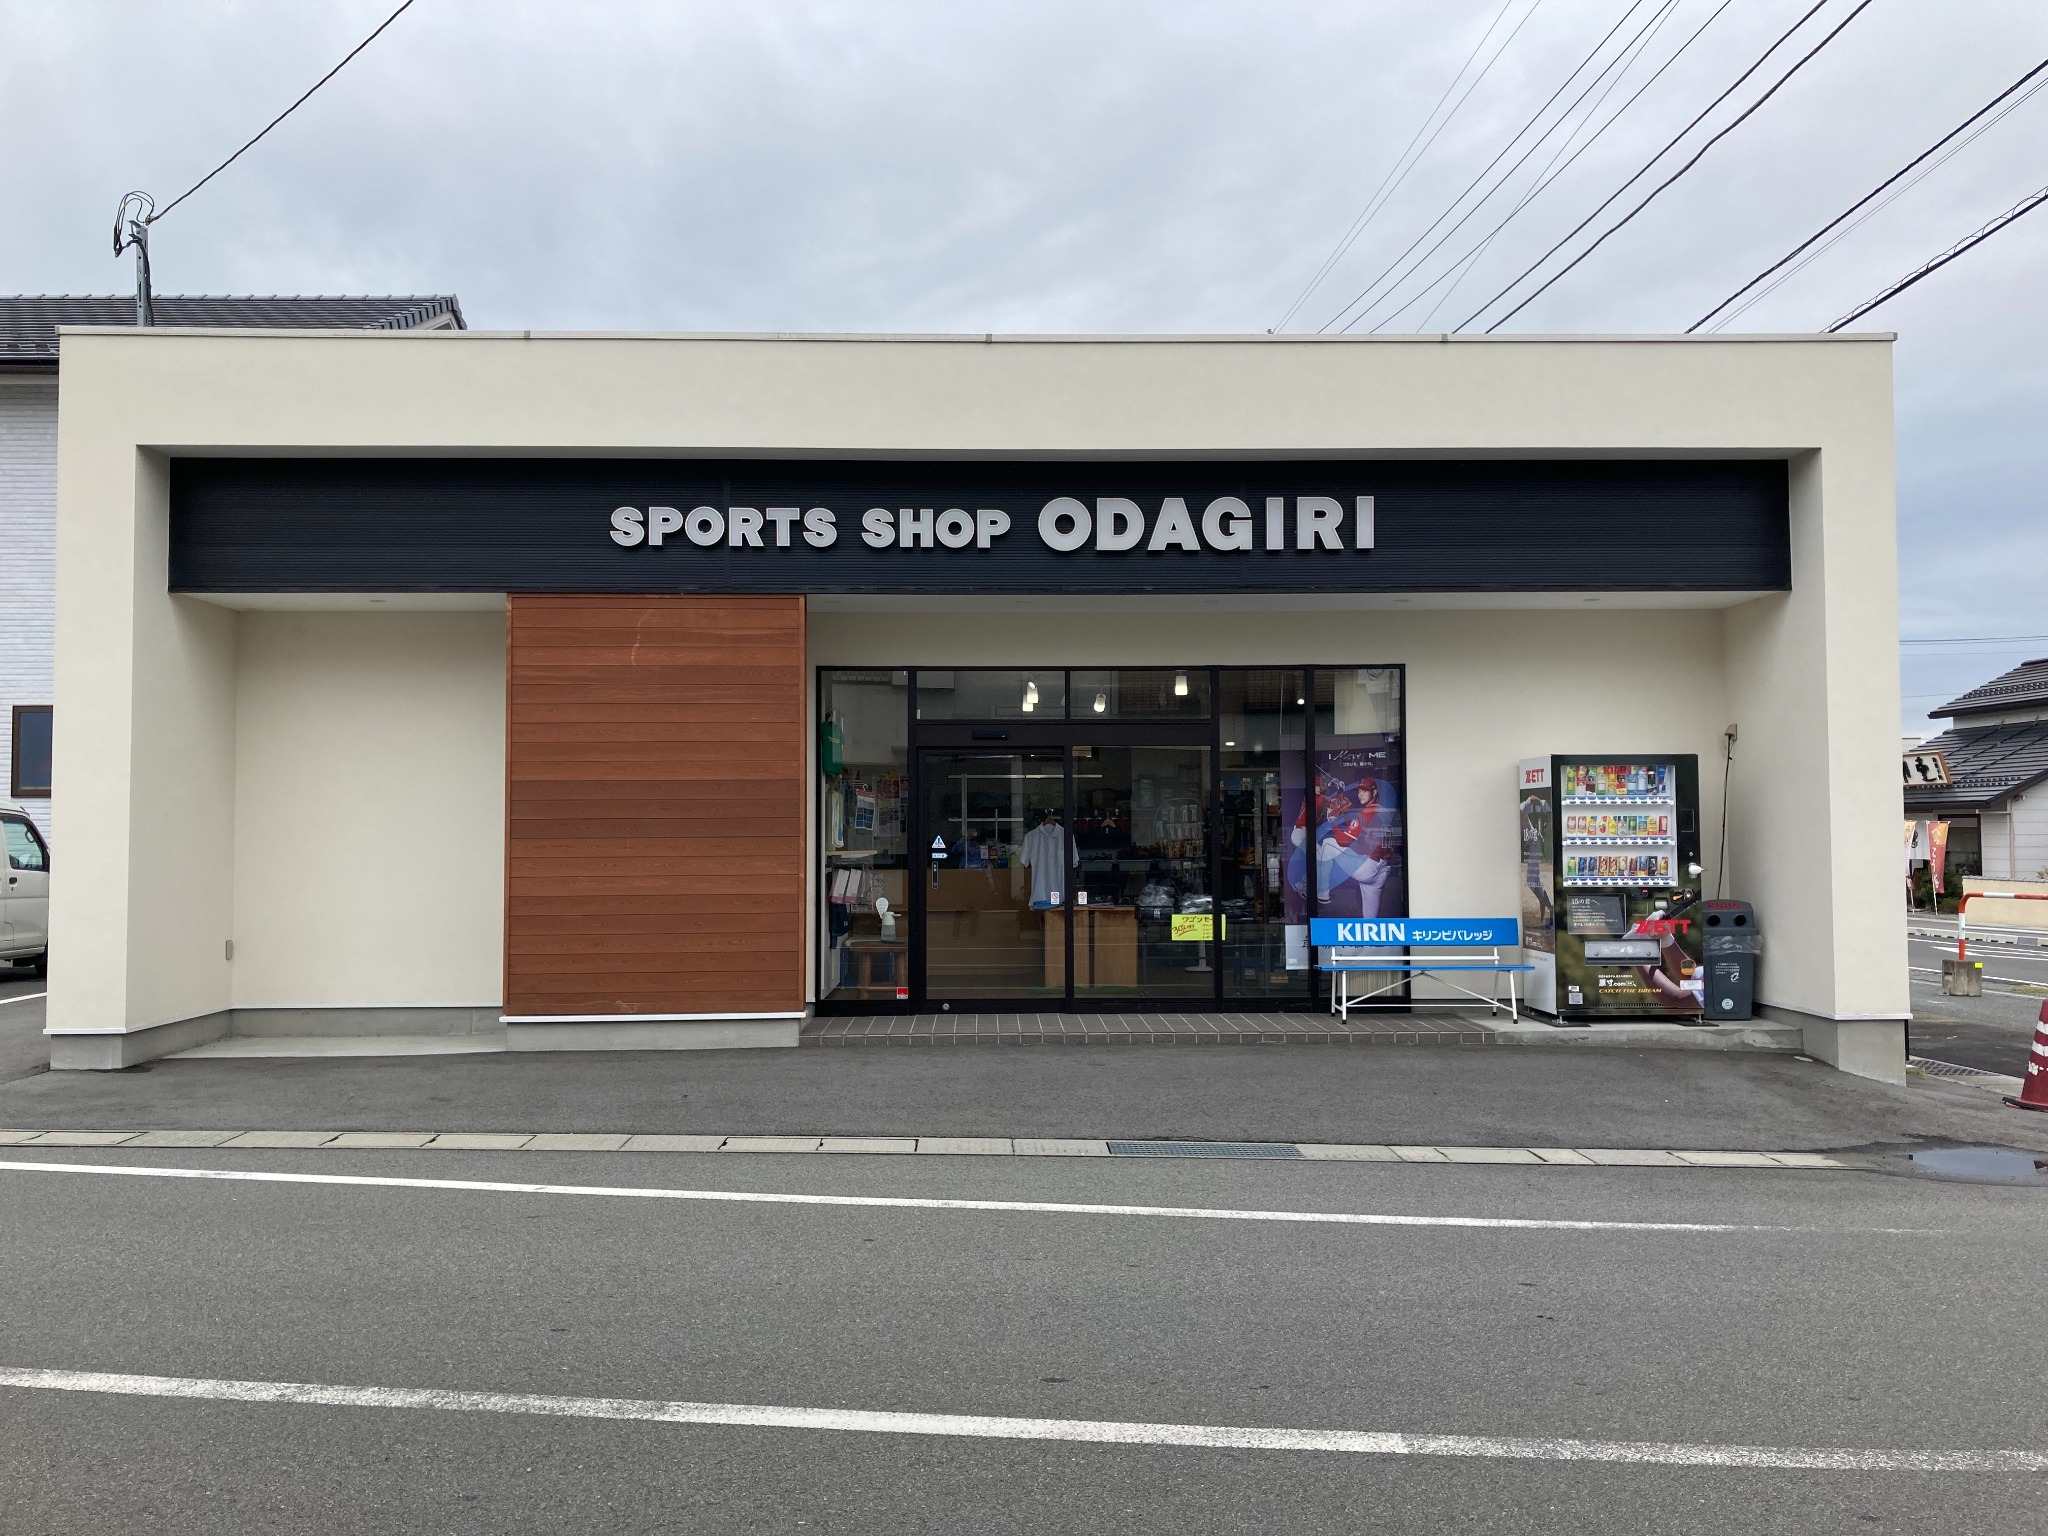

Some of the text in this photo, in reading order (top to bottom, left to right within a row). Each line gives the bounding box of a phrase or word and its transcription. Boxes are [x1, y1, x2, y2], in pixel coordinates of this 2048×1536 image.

[609, 495, 1376, 552] SPORTS SHOP ODAGIRI
[1525, 768, 1544, 784] ZETT
[1337, 922, 1405, 942] KIRIN
[1412, 929, 1493, 941] キリンビバレッジ
[1634, 919, 1692, 935] ZETT
